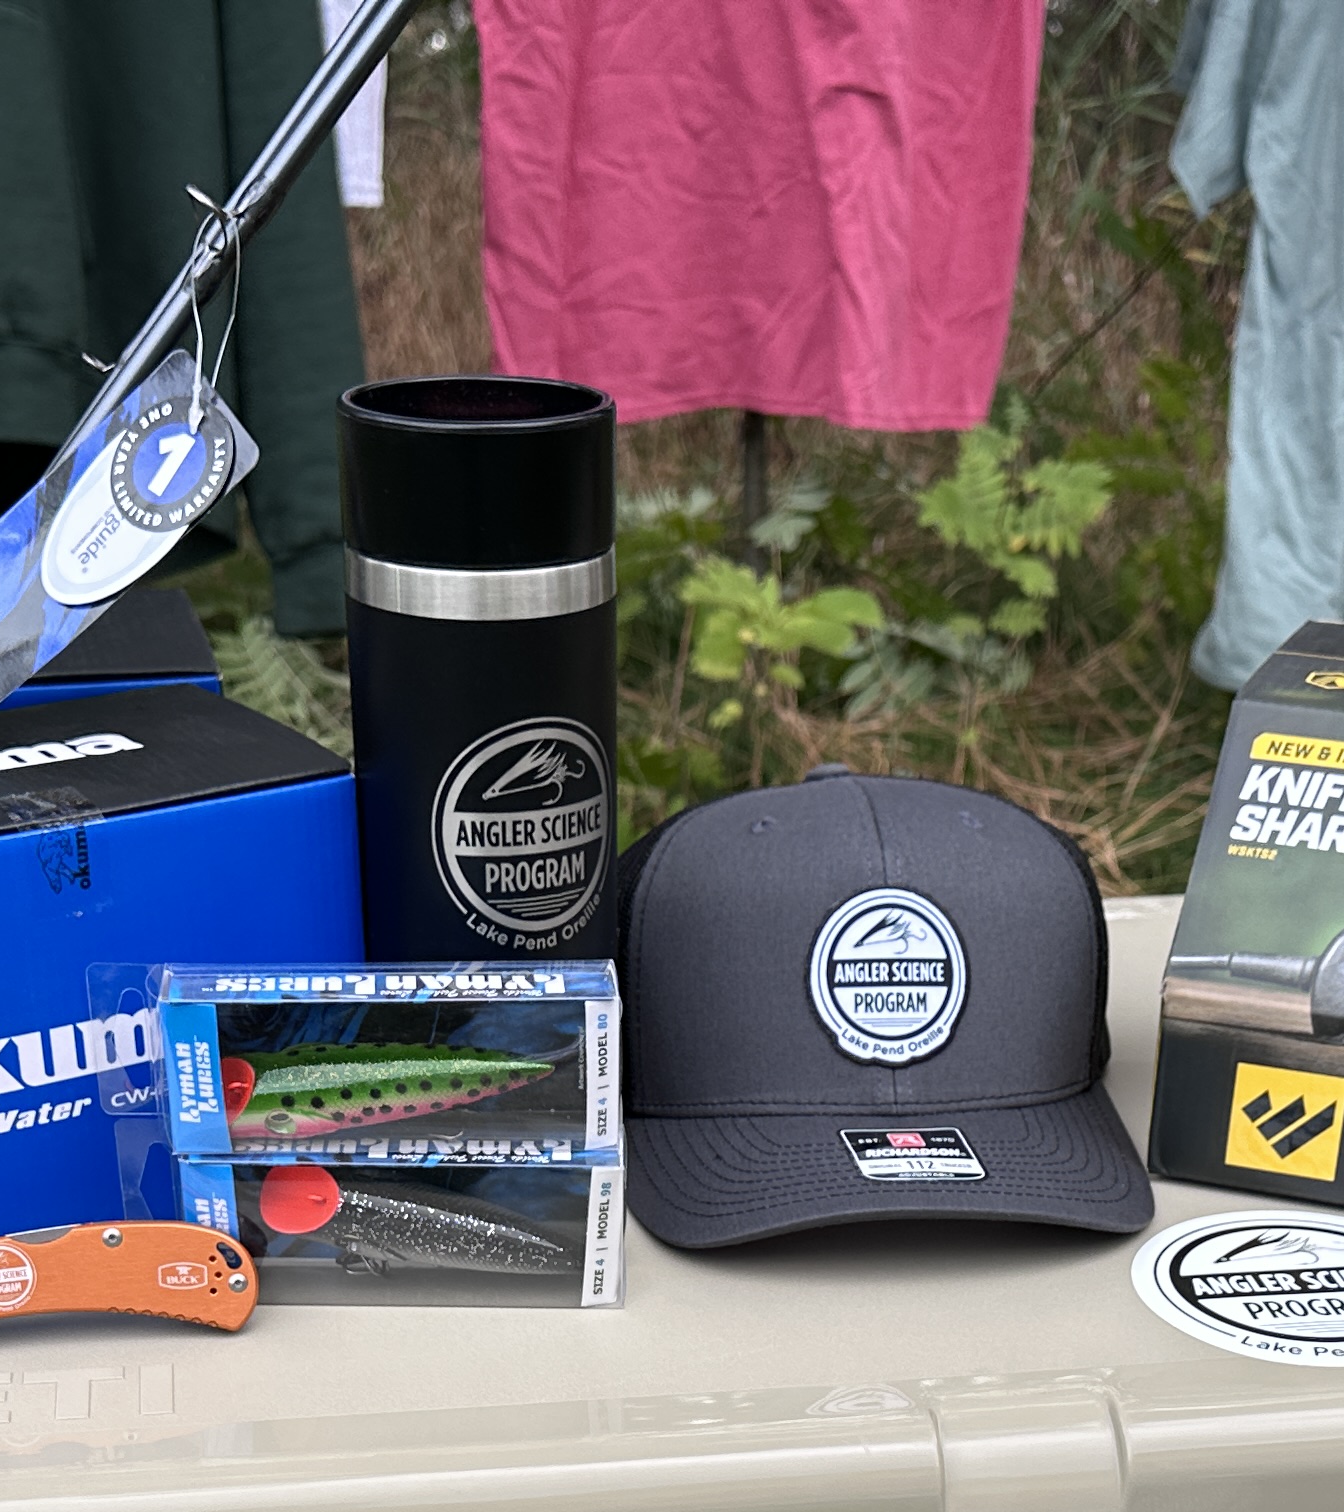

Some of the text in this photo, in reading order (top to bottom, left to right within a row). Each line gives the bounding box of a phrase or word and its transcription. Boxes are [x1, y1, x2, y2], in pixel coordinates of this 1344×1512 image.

[114, 403, 226, 526] ONE YEAR LIMITED WARRANTY
[148, 433, 196, 497] 1
[1267, 741, 1315, 758] NEW
[1318, 746, 1331, 760] &
[456, 801, 601, 847] ANGLER SCIENCE
[485, 851, 585, 893] PROGRAM
[466, 896, 601, 950] Lake Pend Oreille
[834, 962, 945, 983] ANGLER SCIENCE
[854, 992, 928, 1013] PROGRAM
[597, 1032, 608, 1076] MODEL
[841, 1025, 945, 1055] Lake Pend Oreille
[597, 1108, 607, 1136] SIZE
[866, 1148, 960, 1157] RICHARDSON
[906, 1160, 936, 1169] 112
[594, 1182, 611, 1295] SIZE MODEL 98
[2, 1269, 27, 1280] SCIENCE
[167, 1275, 199, 1284] BUCK
[1191, 1270, 1297, 1298] ANGLER
[1240, 1335, 1303, 1358] Lake
